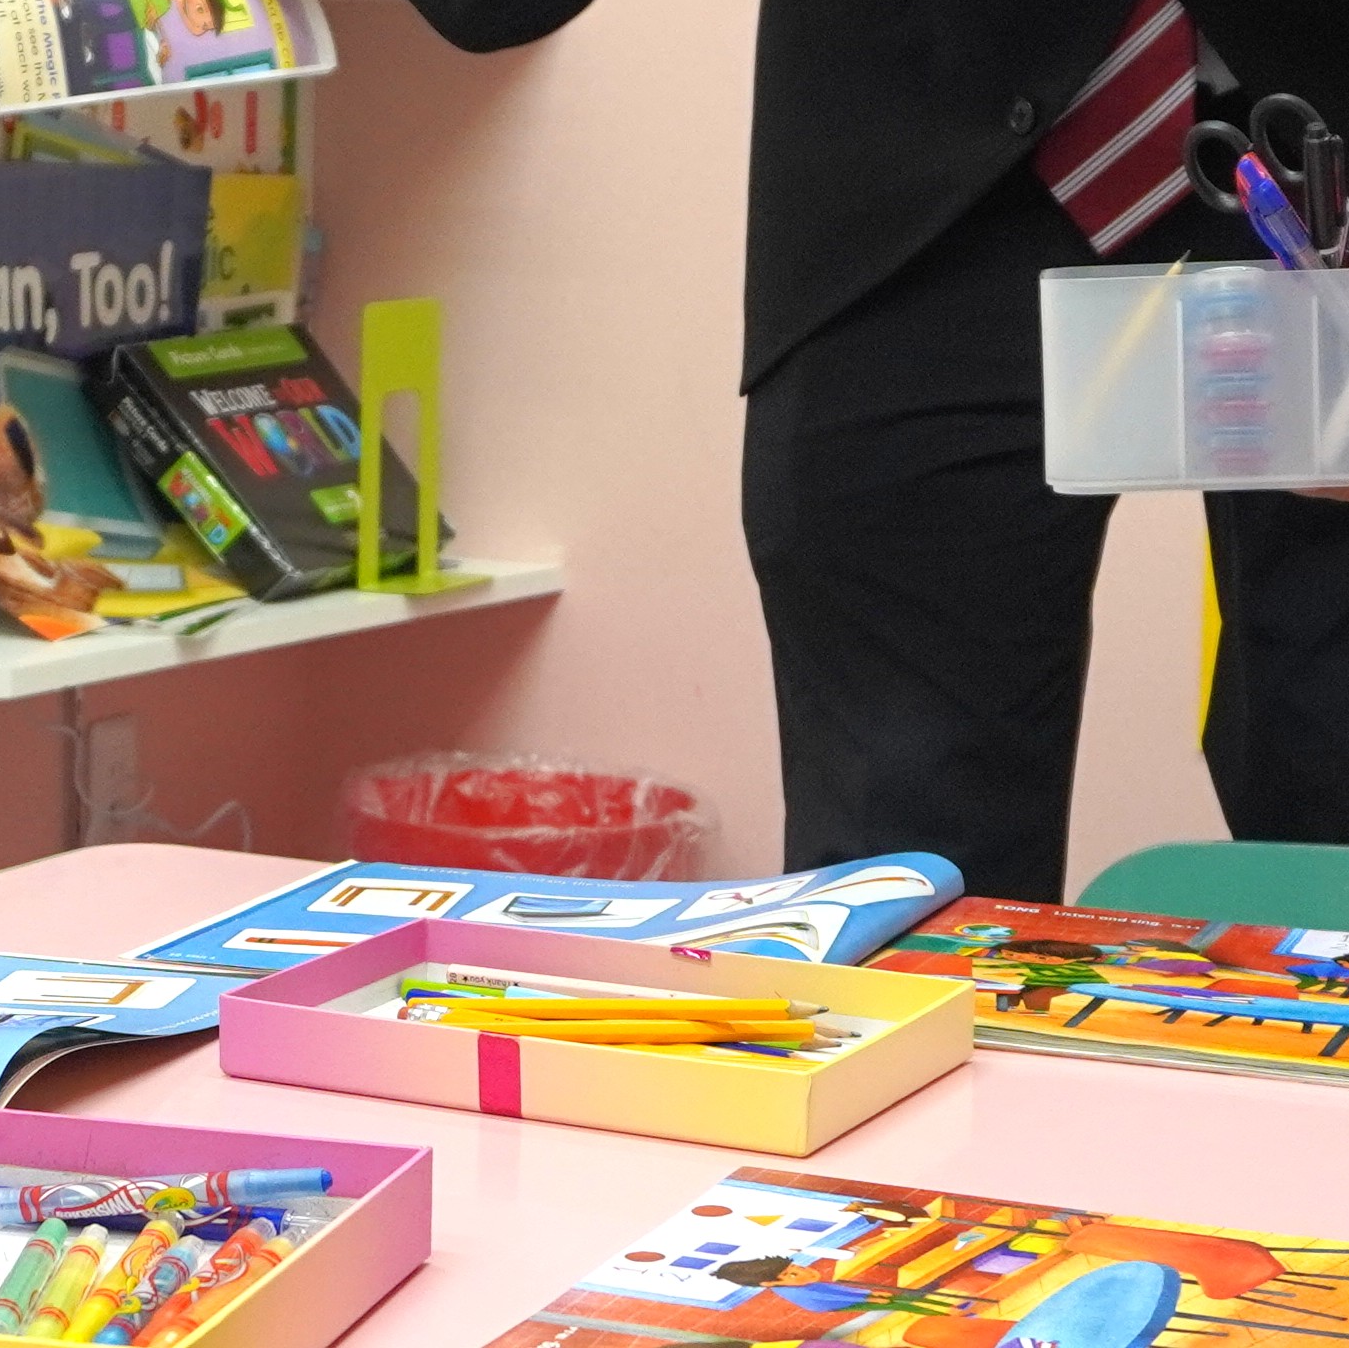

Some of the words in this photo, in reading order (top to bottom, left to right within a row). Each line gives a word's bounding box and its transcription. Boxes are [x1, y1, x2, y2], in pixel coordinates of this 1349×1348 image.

[43, 32, 60, 87] Magic
[70, 240, 173, 328] Too!
[188, 383, 277, 415] WELCOME
[994, 904, 1041, 914] SONG
[1054, 910, 1095, 920] Listen
[1099, 915, 1128, 923] and
